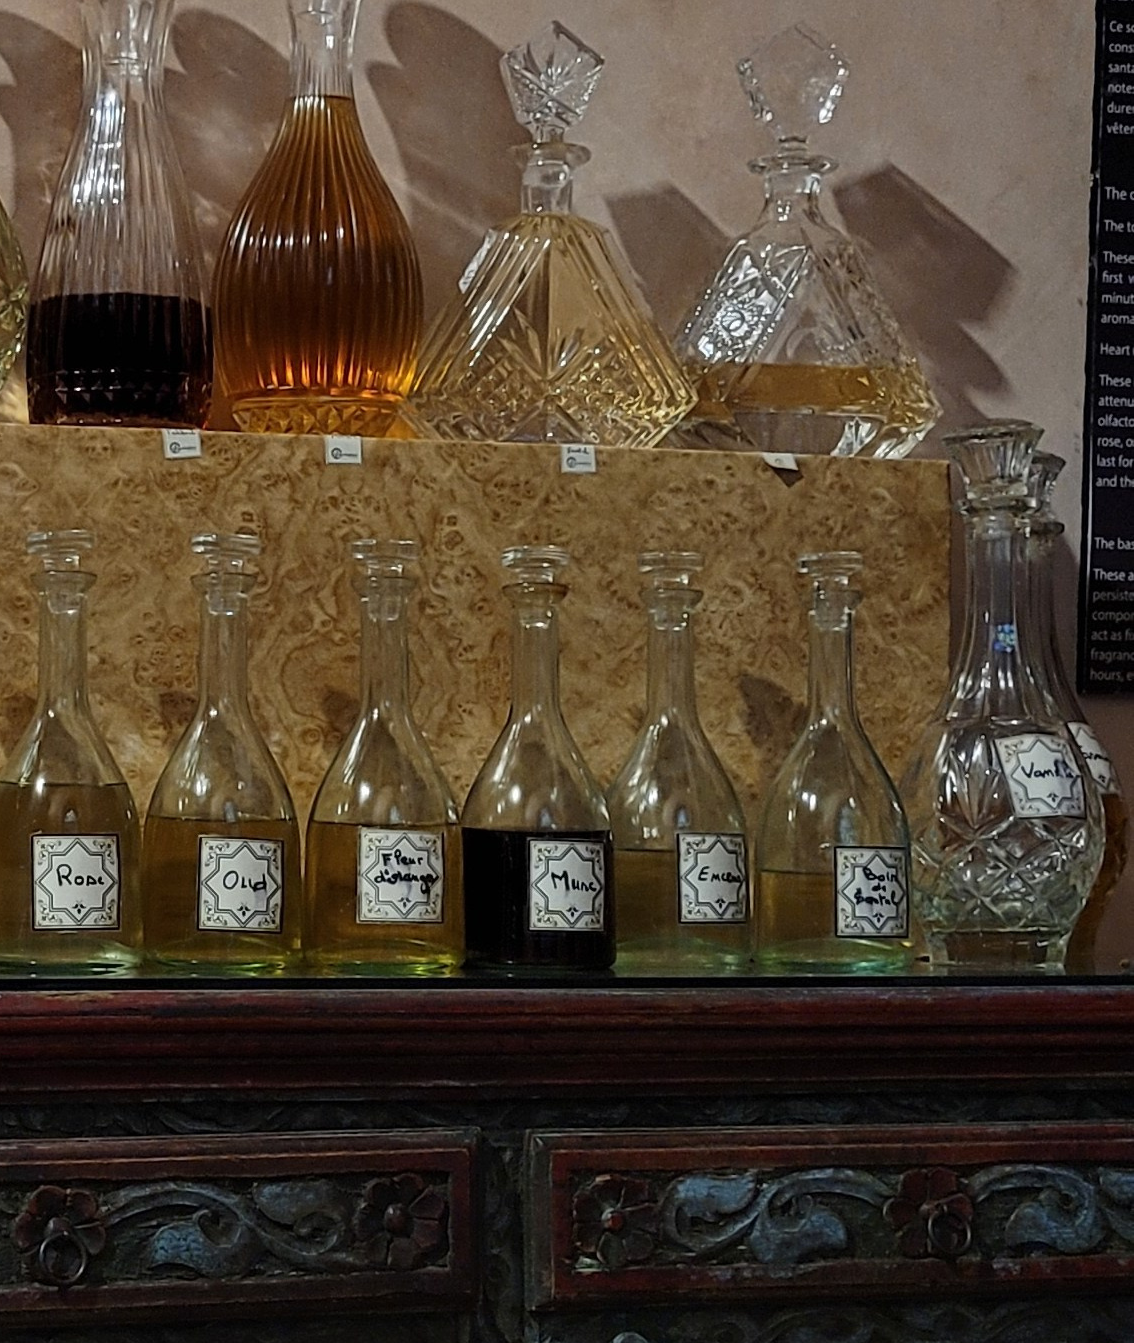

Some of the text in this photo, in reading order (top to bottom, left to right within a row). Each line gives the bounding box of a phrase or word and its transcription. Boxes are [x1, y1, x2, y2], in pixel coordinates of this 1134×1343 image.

[1109, 20, 1123, 33] Ce
[1104, 186, 1127, 201] The
[1103, 219, 1124, 233] The
[1102, 270, 1123, 284] first
[1099, 342, 1130, 356] Heart
[1098, 374, 1132, 387] These
[1096, 453, 1116, 467] last
[1095, 474, 1117, 487] and
[1094, 537, 1115, 550] The
[1093, 568, 1126, 581] These
